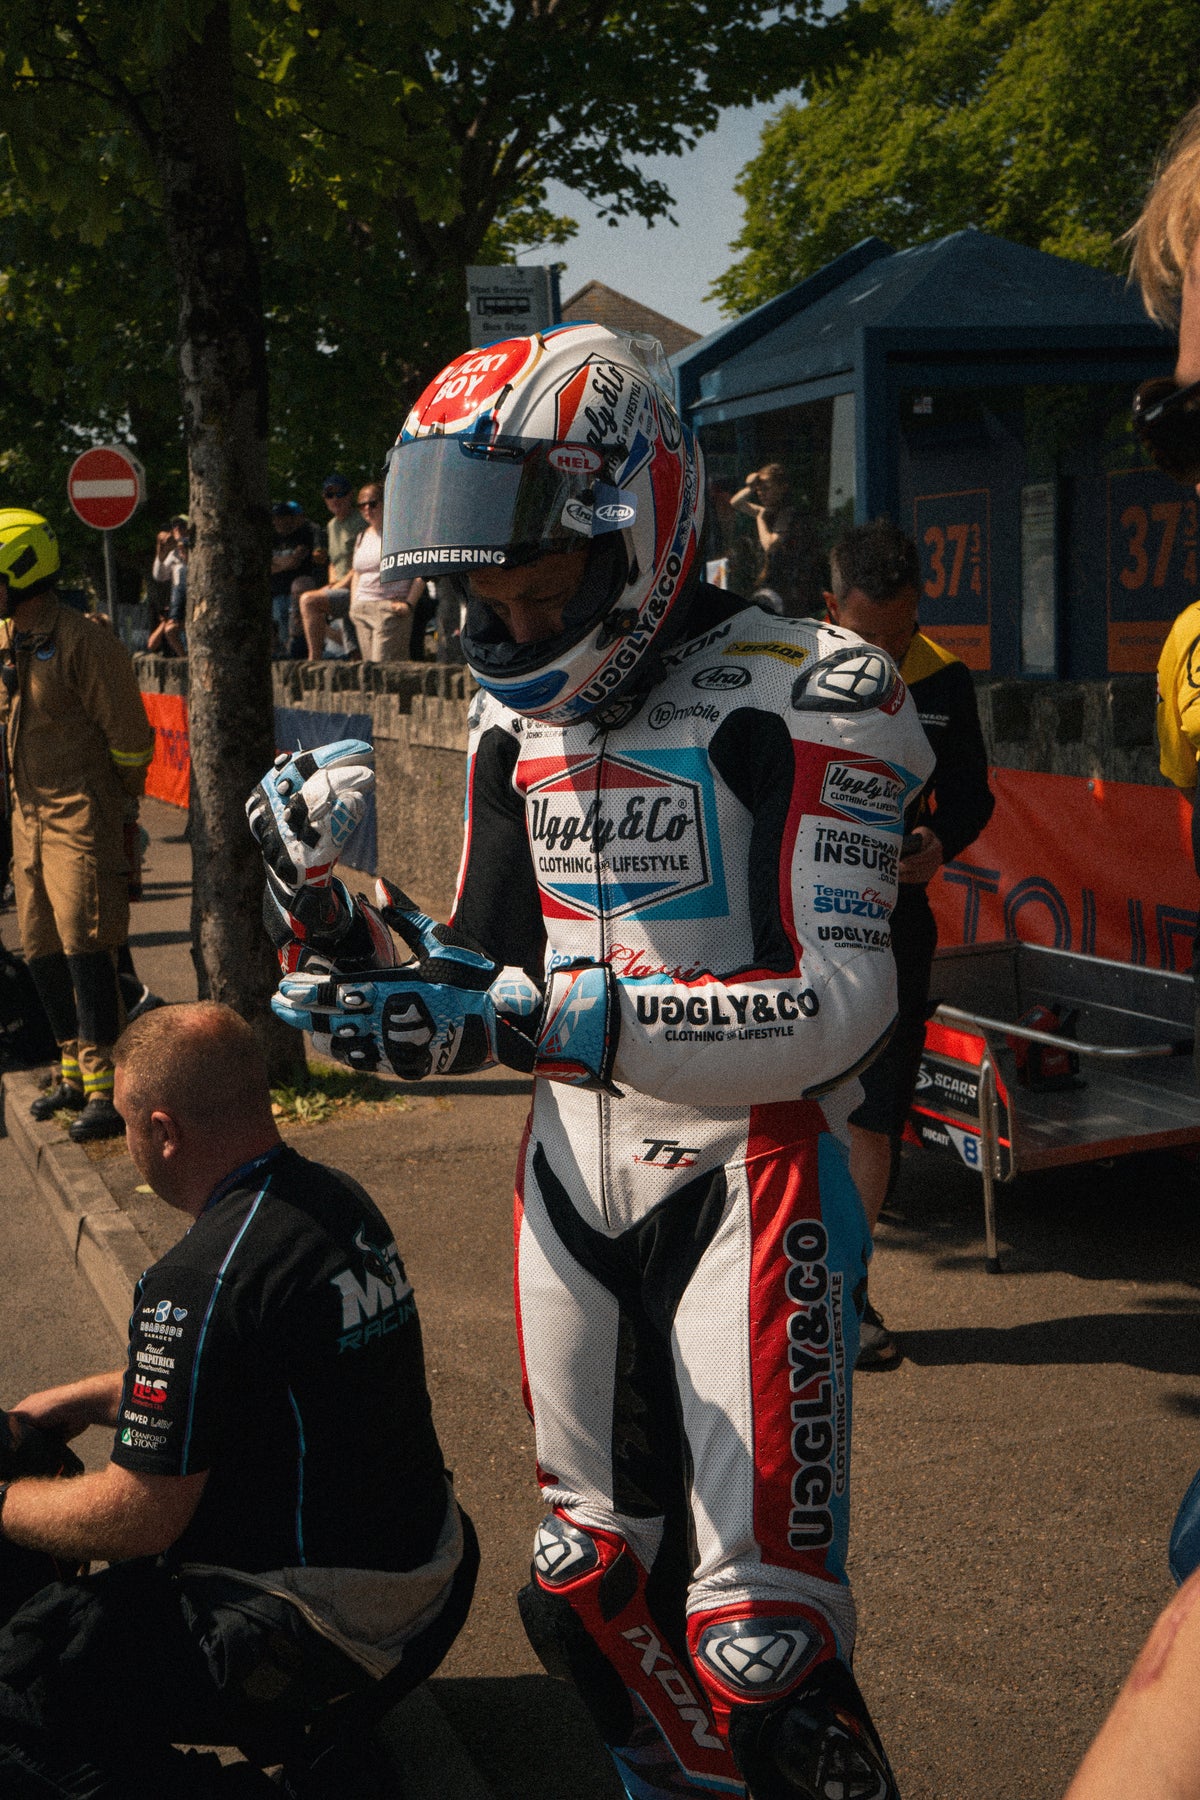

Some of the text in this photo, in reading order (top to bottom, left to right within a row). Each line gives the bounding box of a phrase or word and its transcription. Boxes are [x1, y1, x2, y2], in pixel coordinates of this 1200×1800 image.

[483, 322, 527, 333] Bus Stop
[434, 353, 508, 384] LUCKY
[431, 374, 487, 405] BOY
[624, 381, 642, 428] LIFESTYLE
[557, 455, 594, 470] HEL
[570, 505, 592, 520] Ara
[600, 504, 631, 517] Arai
[1119, 503, 1182, 590] 37
[396, 549, 506, 567] ENGINEERING
[924, 524, 969, 599] 37
[581, 554, 681, 702] UGGLY&CO
[738, 643, 804, 660] DUNLOP
[830, 791, 868, 806] CLOTHING
[538, 856, 593, 873] CLOTHING
[612, 854, 690, 872] LIFESTYLE
[814, 842, 898, 879] INSURE
[813, 884, 859, 899] Team
[636, 987, 821, 1027] UGGLY&CO
[665, 1029, 725, 1043] CLOTHING
[738, 1026, 795, 1042] LIFESTYLE
[934, 1072, 978, 1099] SCARS
[641, 1138, 702, 1170] TT
[962, 1135, 979, 1165] 8
[140, 1321, 184, 1338] ROADSIDE
[831, 1271, 844, 1371] LIFESTYLE
[145, 1343, 165, 1355] Paul
[136, 1351, 175, 1370] KIRKPATRICK
[784, 1219, 834, 1550] UGGLY&CO
[124, 1409, 149, 1426] GLOVER
[131, 1429, 168, 1445] CRANFORD
[133, 1437, 160, 1451] STONE
[835, 1395, 847, 1496] CLOTHING
[620, 1623, 726, 1751] IXON
